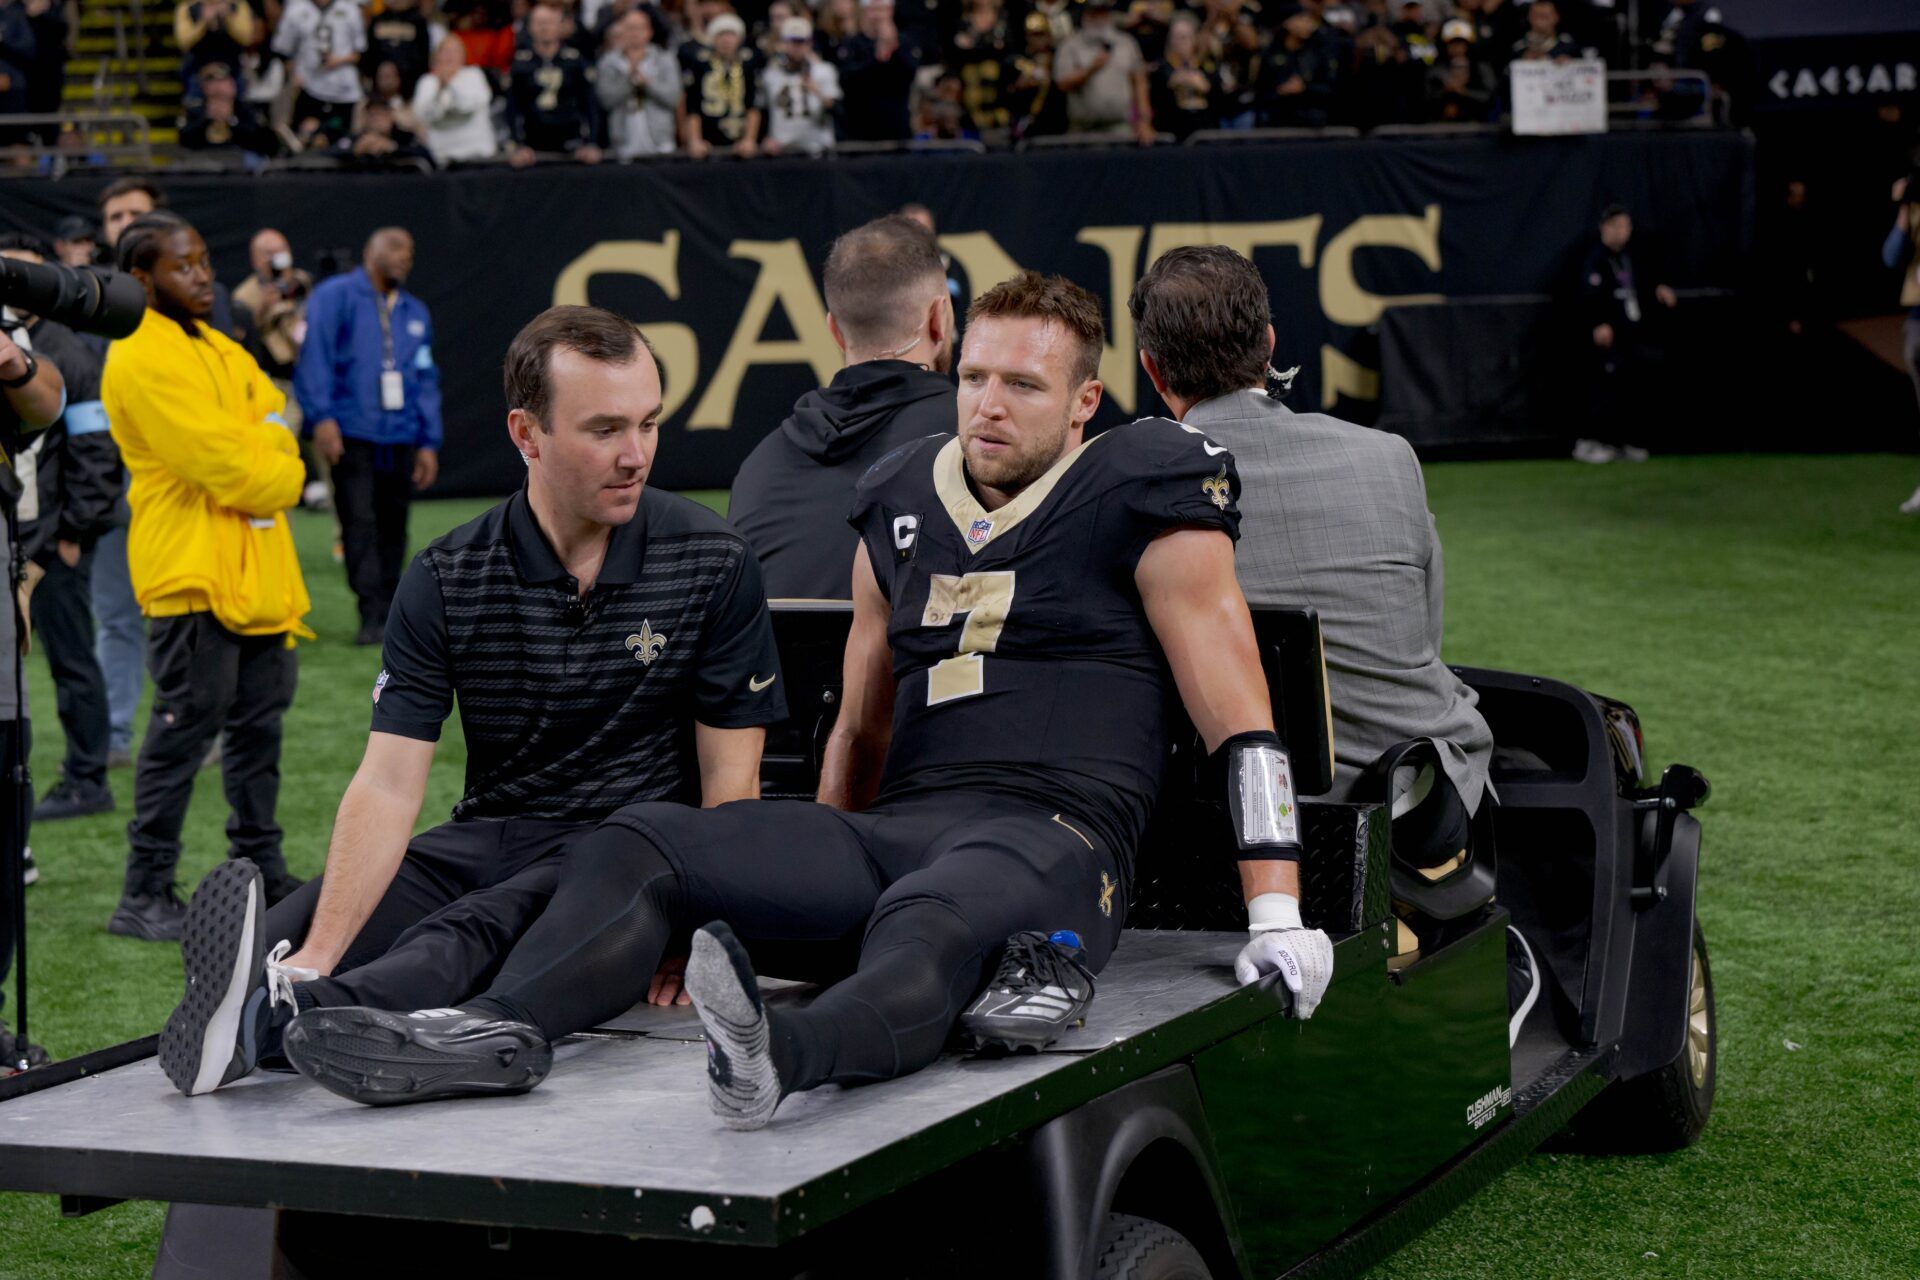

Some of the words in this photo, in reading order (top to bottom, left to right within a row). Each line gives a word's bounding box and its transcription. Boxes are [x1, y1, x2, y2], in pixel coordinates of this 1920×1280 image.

[534, 66, 563, 111] 7
[1768, 62, 1917, 98] CAESAR
[553, 204, 1443, 429] SANTS
[893, 515, 917, 549] C
[921, 570, 1015, 706] 7
[1466, 1084, 1502, 1121] CUSHMAN
[1474, 1111, 1493, 1130] SHUTTLE
